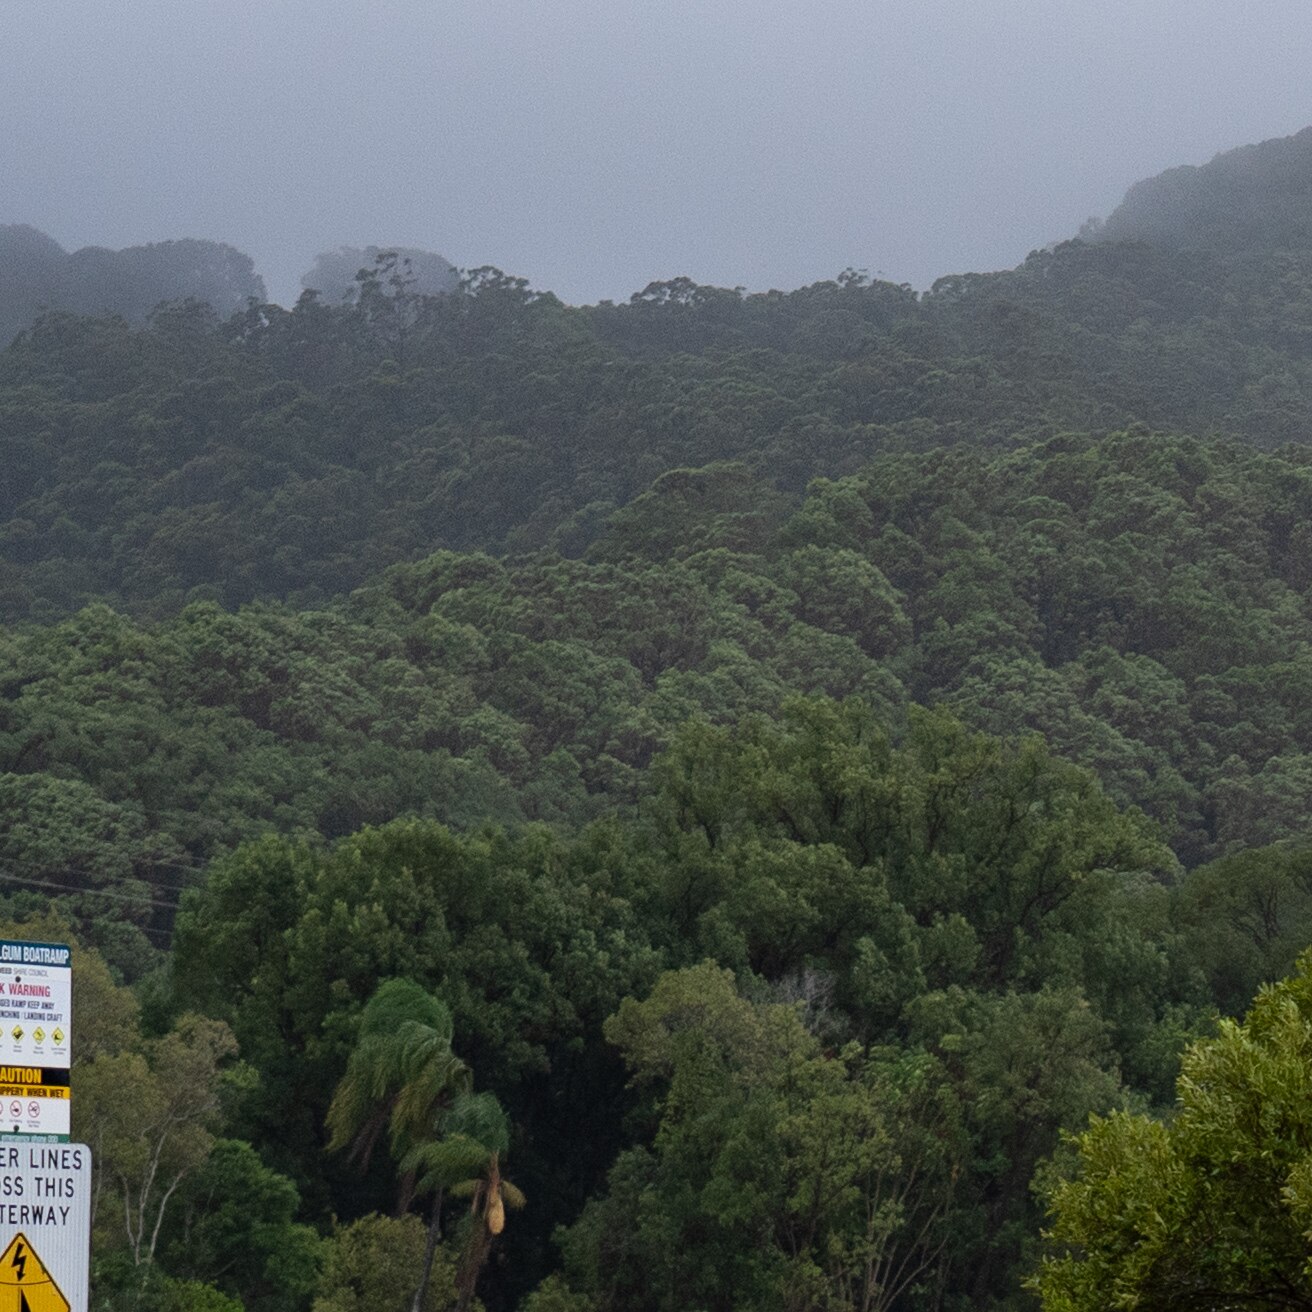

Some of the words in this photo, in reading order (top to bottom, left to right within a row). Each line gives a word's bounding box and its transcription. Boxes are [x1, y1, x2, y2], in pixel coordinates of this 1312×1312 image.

[0, 944, 22, 962] GUM
[23, 946, 70, 964] BOATRAMP
[8, 984, 51, 998] WARNING
[0, 1066, 42, 1084] AUTION
[50, 1089, 65, 1098] WET
[30, 1148, 82, 1170] LINES
[0, 1175, 24, 1197] SS
[34, 1177, 74, 1198] THIS
